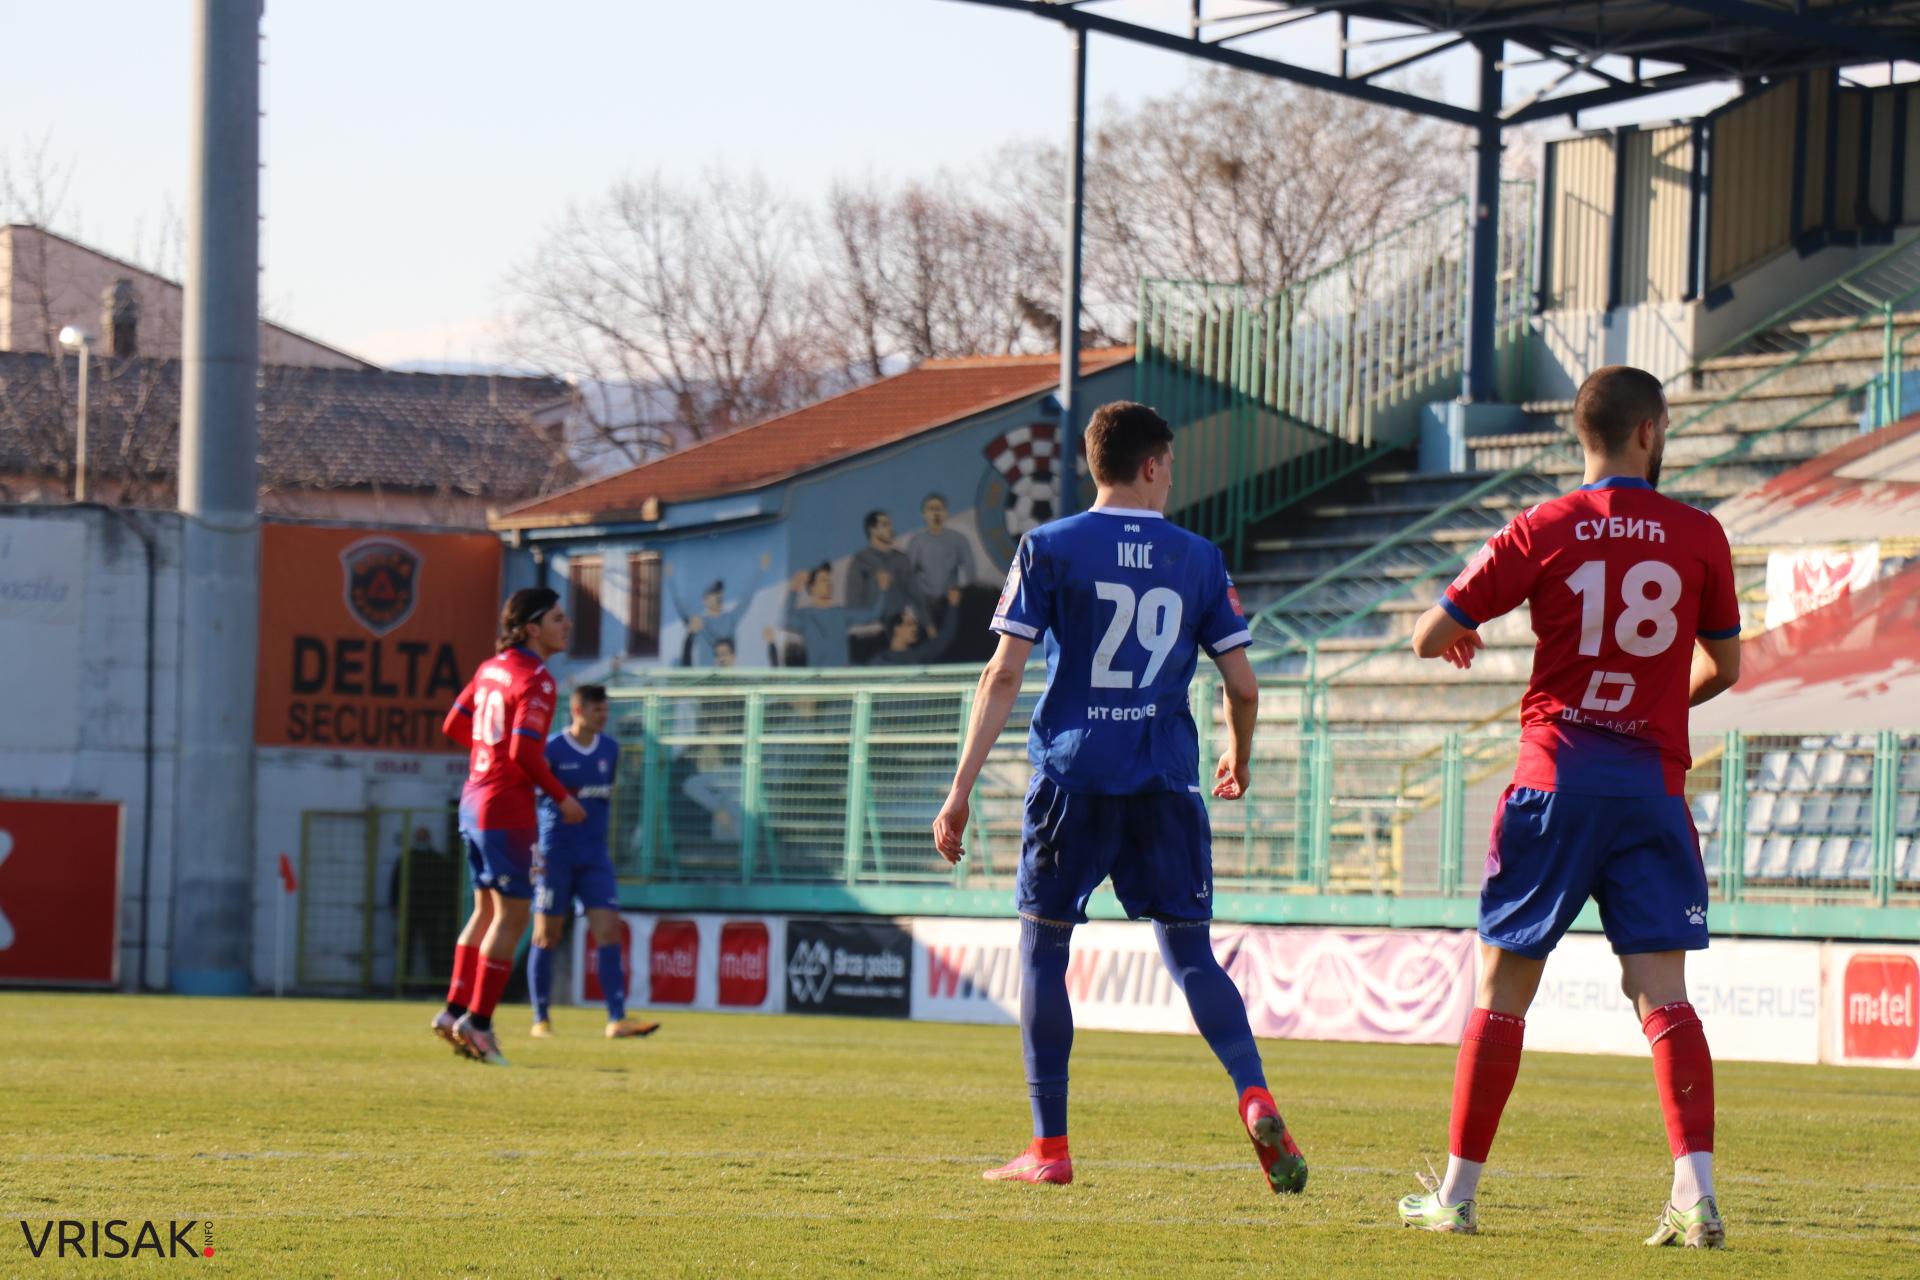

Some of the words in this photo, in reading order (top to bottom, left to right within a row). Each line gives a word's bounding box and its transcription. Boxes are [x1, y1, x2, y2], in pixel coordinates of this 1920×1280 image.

[1574, 516, 1665, 544] СУБИЋ
[1117, 541, 1154, 569] IKIĆ
[1564, 560, 1683, 658] 18
[1090, 581, 1184, 689] 29
[291, 636, 462, 698] DELTA
[1533, 979, 1634, 1011] MERU
[1694, 985, 1817, 1018] EMERUS
[1849, 983, 1912, 1027] m:tel
